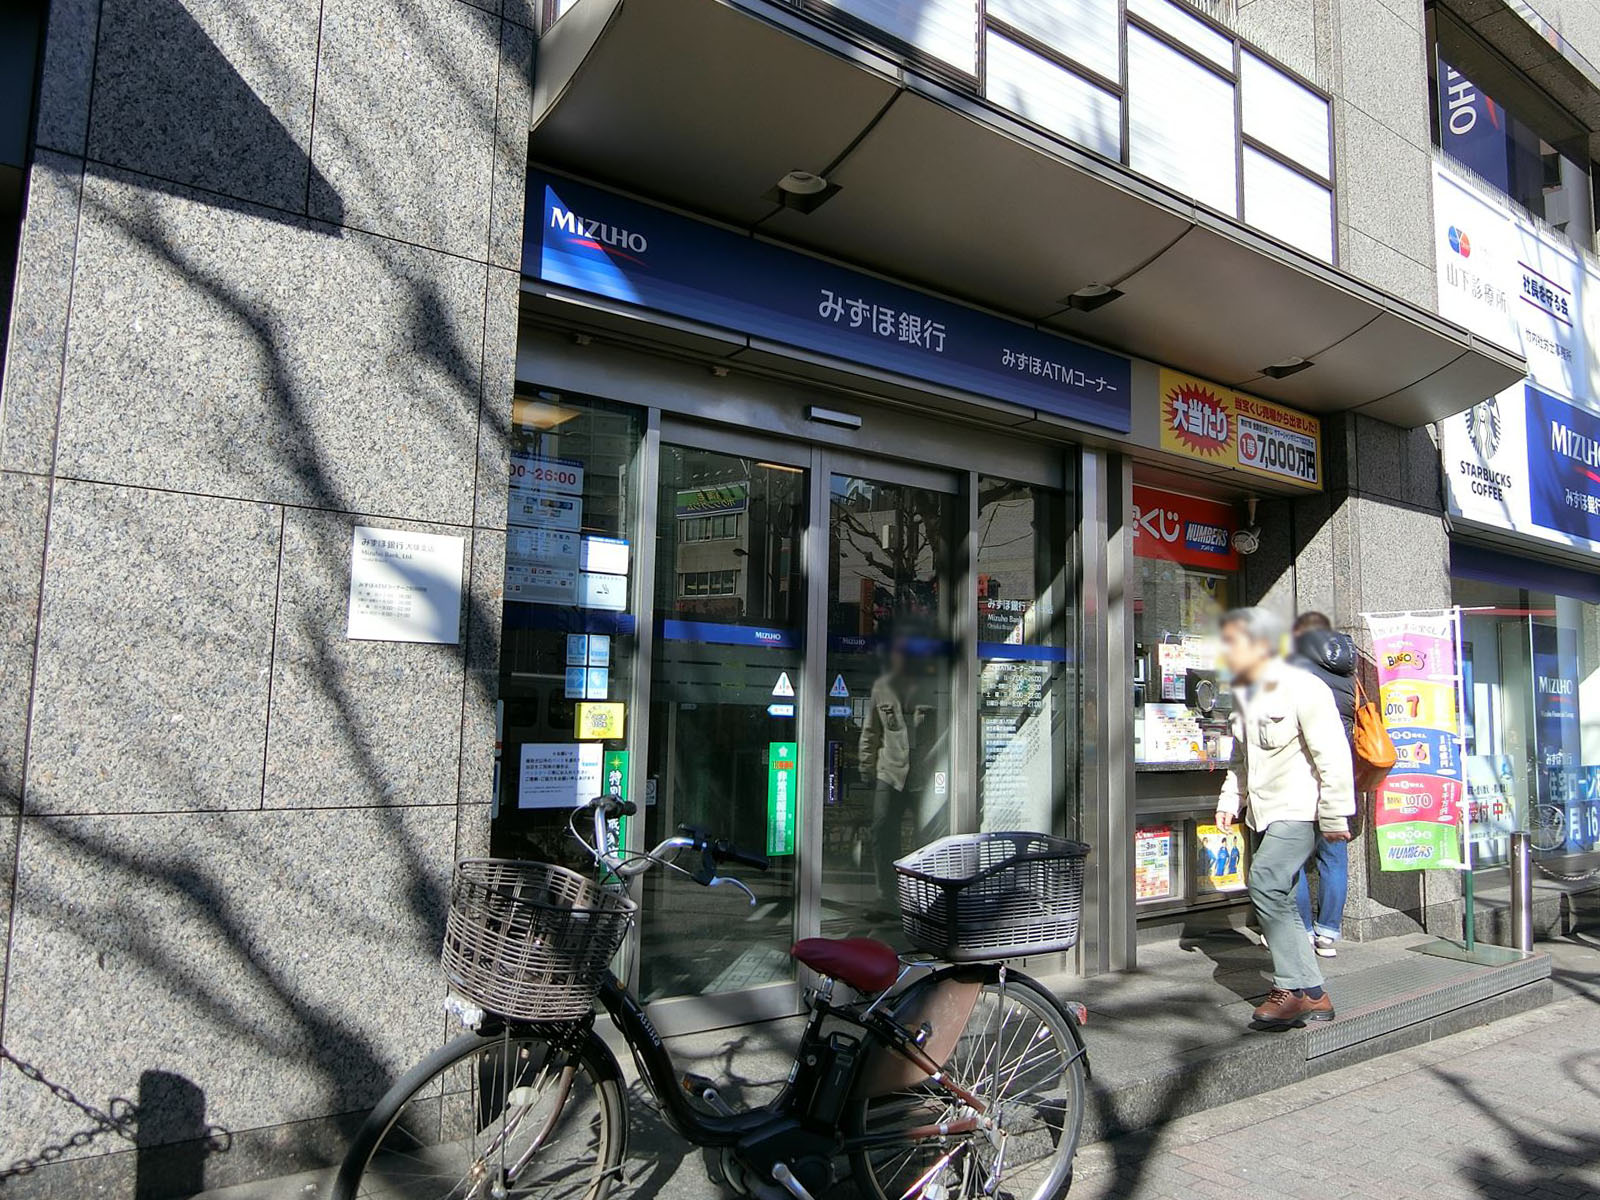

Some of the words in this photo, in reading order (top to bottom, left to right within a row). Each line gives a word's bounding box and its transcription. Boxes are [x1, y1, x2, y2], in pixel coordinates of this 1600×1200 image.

[551, 206, 648, 253] MIZUHO
[1446, 262, 1507, 313] 山下診療所
[1522, 273, 1570, 317] 社長を守る会
[818, 288, 947, 353] みずほ銀行
[1001, 348, 1118, 393] みずほATMコーナー
[1171, 393, 1228, 443] 大当たり
[1551, 420, 1600, 468] MIZUH
[1256, 434, 1317, 480] 7,000万円
[1460, 460, 1512, 489] STARBUCKS
[1471, 480, 1503, 502] COFFEE
[361, 537, 404, 550] みずほ銀行
[1186, 523, 1228, 547] NUMBERS
[987, 598, 1026, 612] みずほ銀行
[755, 631, 782, 641] MIZUHO
[1386, 653, 1412, 667] BINGO
[1538, 675, 1574, 695] MIZUHO
[1406, 695, 1420, 718] 7
[1413, 742, 1427, 761] 6
[1405, 793, 1432, 809] LOTO
[1388, 845, 1433, 859] NUMBERS
